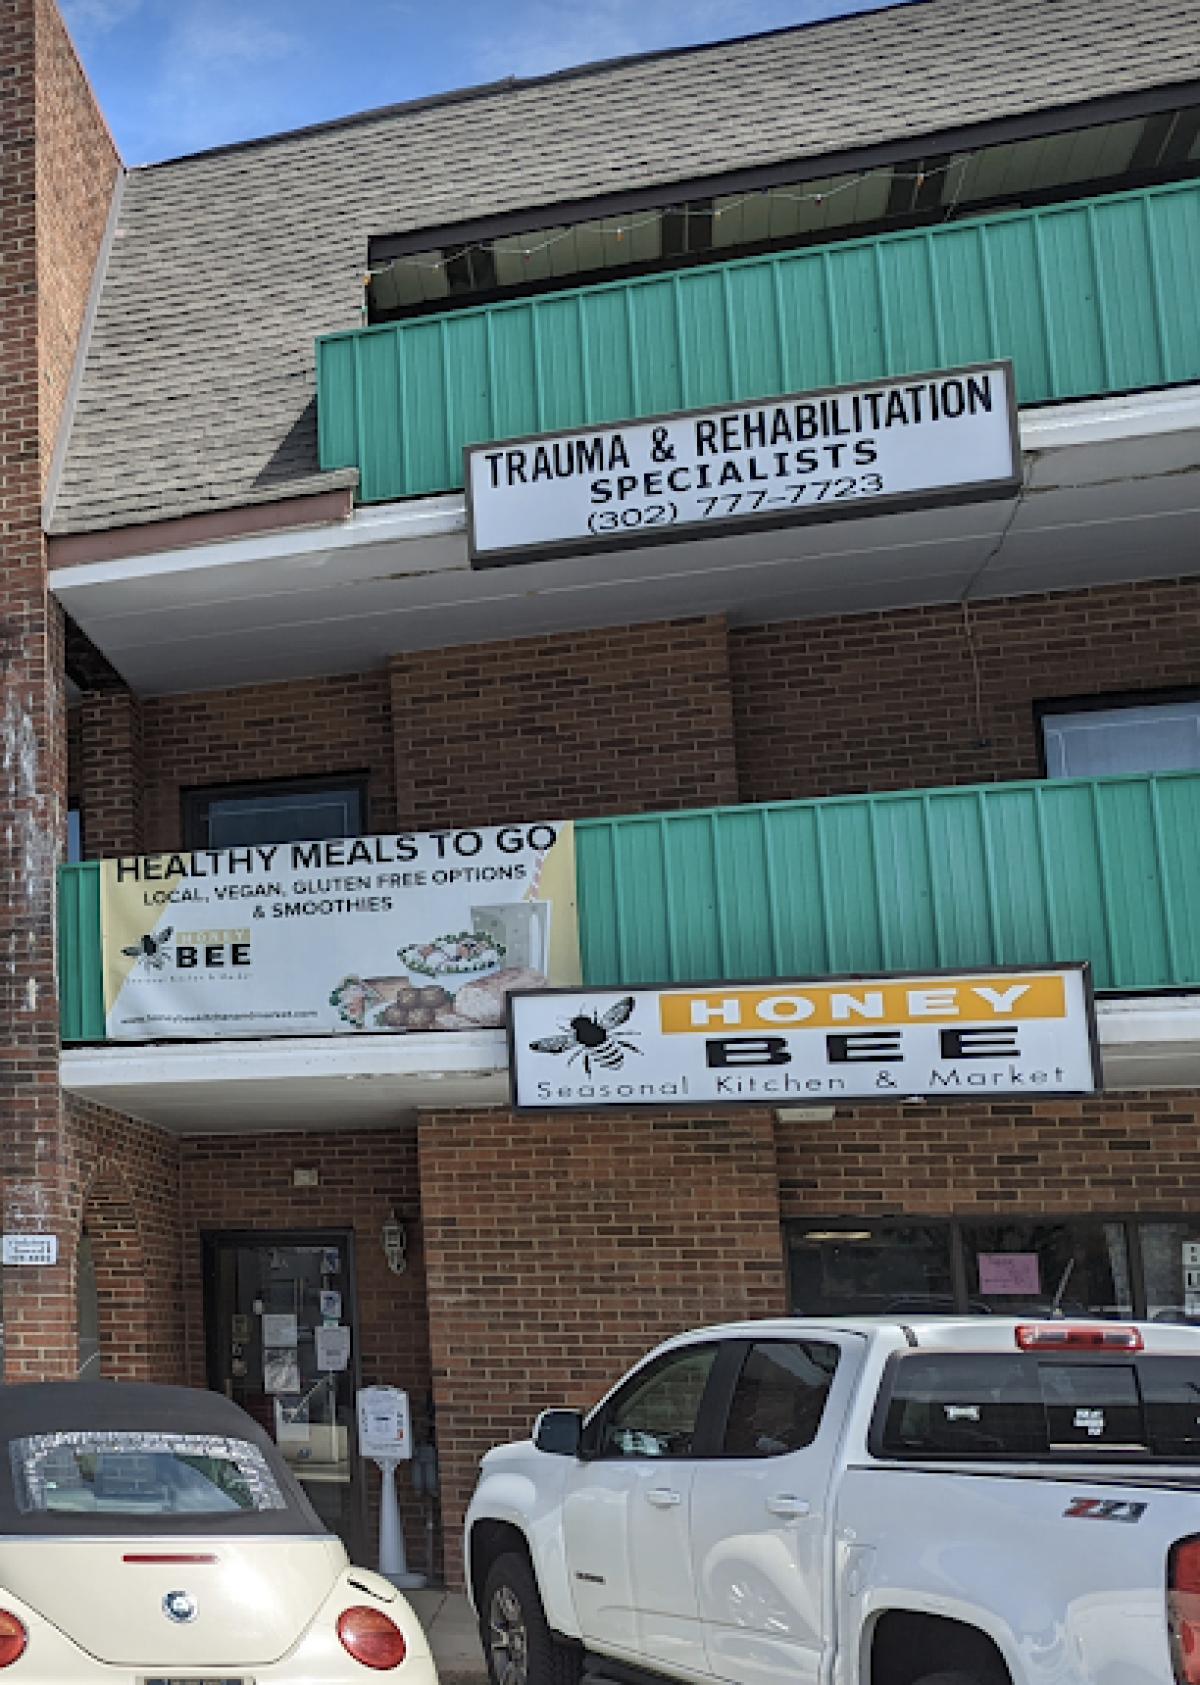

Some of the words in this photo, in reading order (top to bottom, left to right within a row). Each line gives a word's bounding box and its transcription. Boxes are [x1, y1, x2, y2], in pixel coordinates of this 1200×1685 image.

[485, 433, 630, 489] TRAUMA
[650, 425, 675, 464] &
[696, 375, 993, 457] REHABILITATION
[589, 438, 878, 504] SPECIALISTS
[587, 502, 679, 534] (302)
[701, 472, 884, 518] 777-7723
[116, 845, 278, 883] HEALTHY
[291, 835, 418, 871] MEALS
[429, 830, 483, 859] TO
[496, 824, 557, 854] GO
[143, 884, 209, 907] LOCAL,
[214, 880, 286, 900] VEGAN,
[293, 874, 371, 896] GLUTEN
[376, 870, 428, 889] FREE
[431, 864, 528, 887] OPTIONS
[252, 904, 265, 919] &
[272, 896, 393, 919] SMOOTHIES
[176, 943, 251, 968] BEE
[690, 984, 1032, 1026] HONEY
[705, 1026, 1021, 1069] BEE
[537, 1075, 689, 1100] Seasonal
[716, 1073, 845, 1096] Kitchen
[876, 1070, 898, 1090] &
[930, 1065, 1065, 1088] Market
